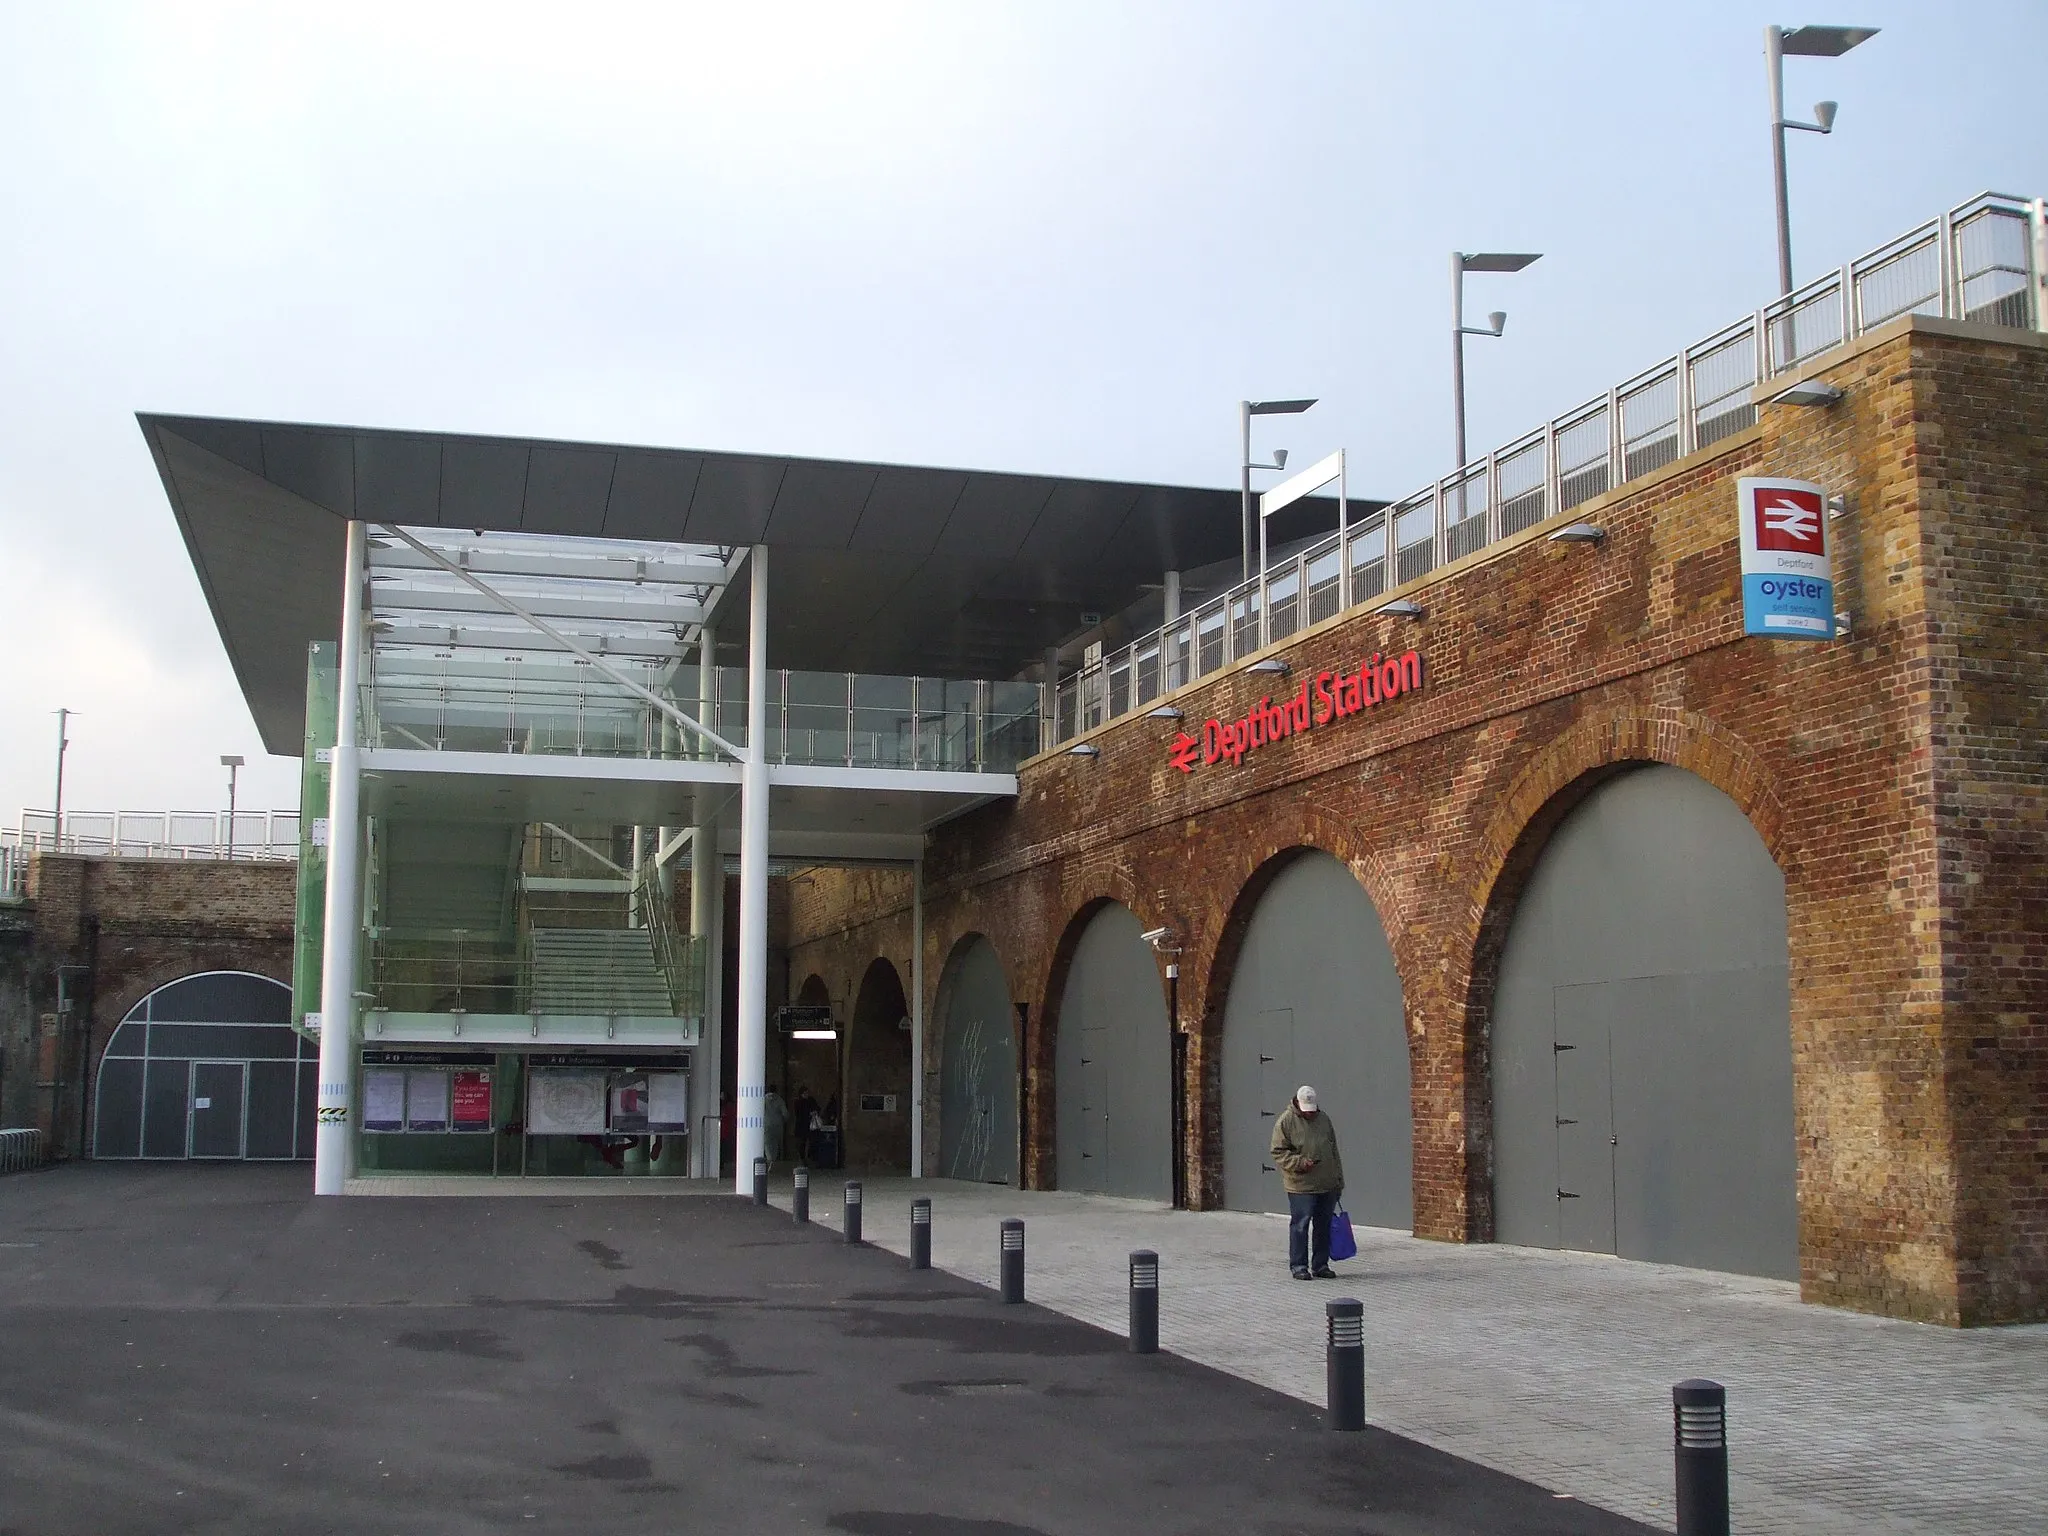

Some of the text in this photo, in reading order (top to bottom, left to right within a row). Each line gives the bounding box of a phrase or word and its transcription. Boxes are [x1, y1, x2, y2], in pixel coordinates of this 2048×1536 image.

[1777, 557, 1814, 570] Deptford
[1761, 579, 1824, 600] oyster
[1790, 605, 1818, 615] service
[1787, 618, 1809, 627] zone 2
[1204, 650, 1422, 766] Deptford Station
